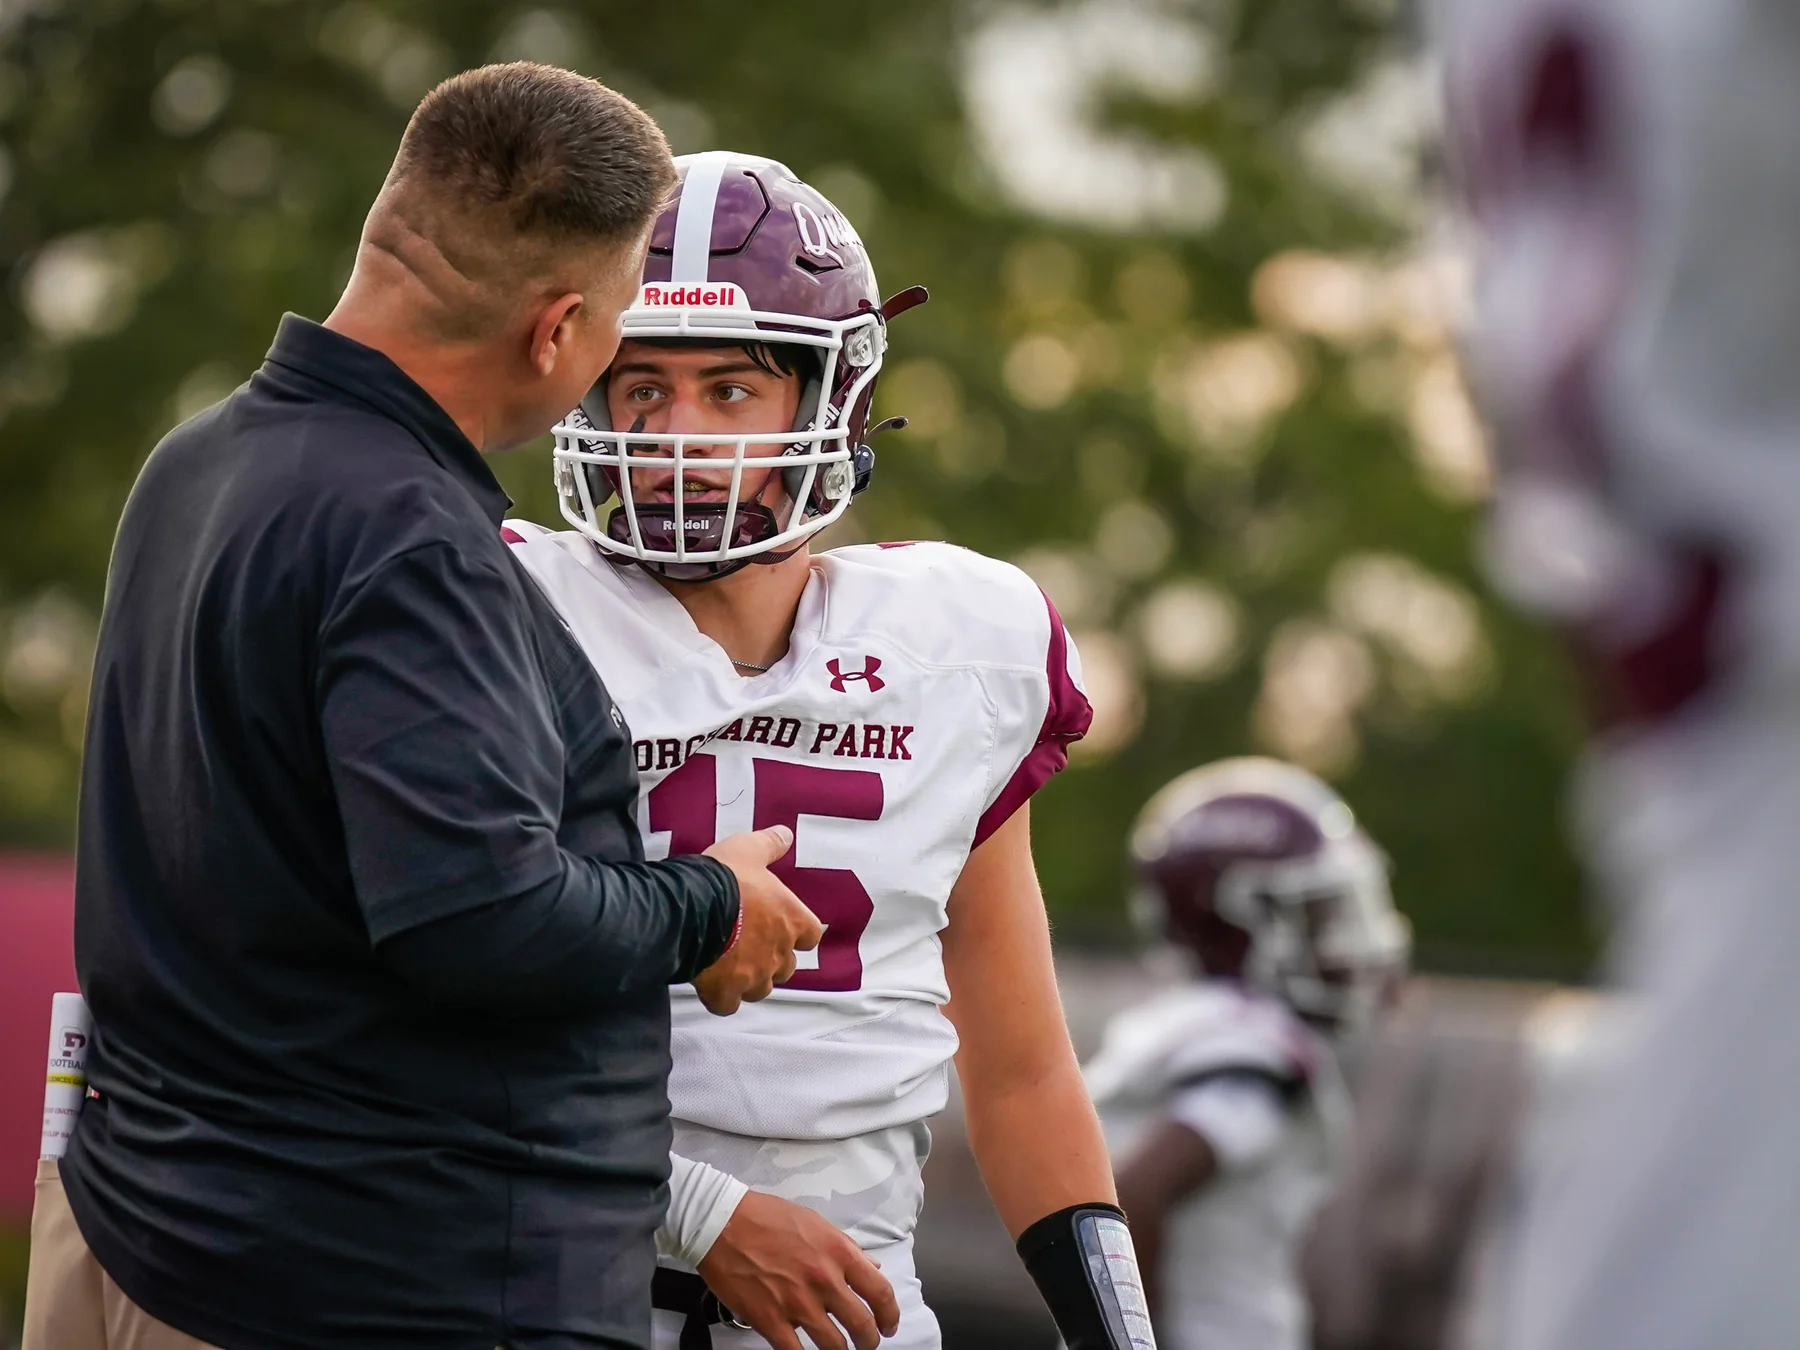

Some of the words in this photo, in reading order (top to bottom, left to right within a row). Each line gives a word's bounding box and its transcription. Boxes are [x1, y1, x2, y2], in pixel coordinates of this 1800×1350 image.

[645, 287, 735, 306] Riddell
[662, 519, 710, 531] Ridell
[809, 722, 914, 761] PARK
[648, 753, 885, 992] 15
